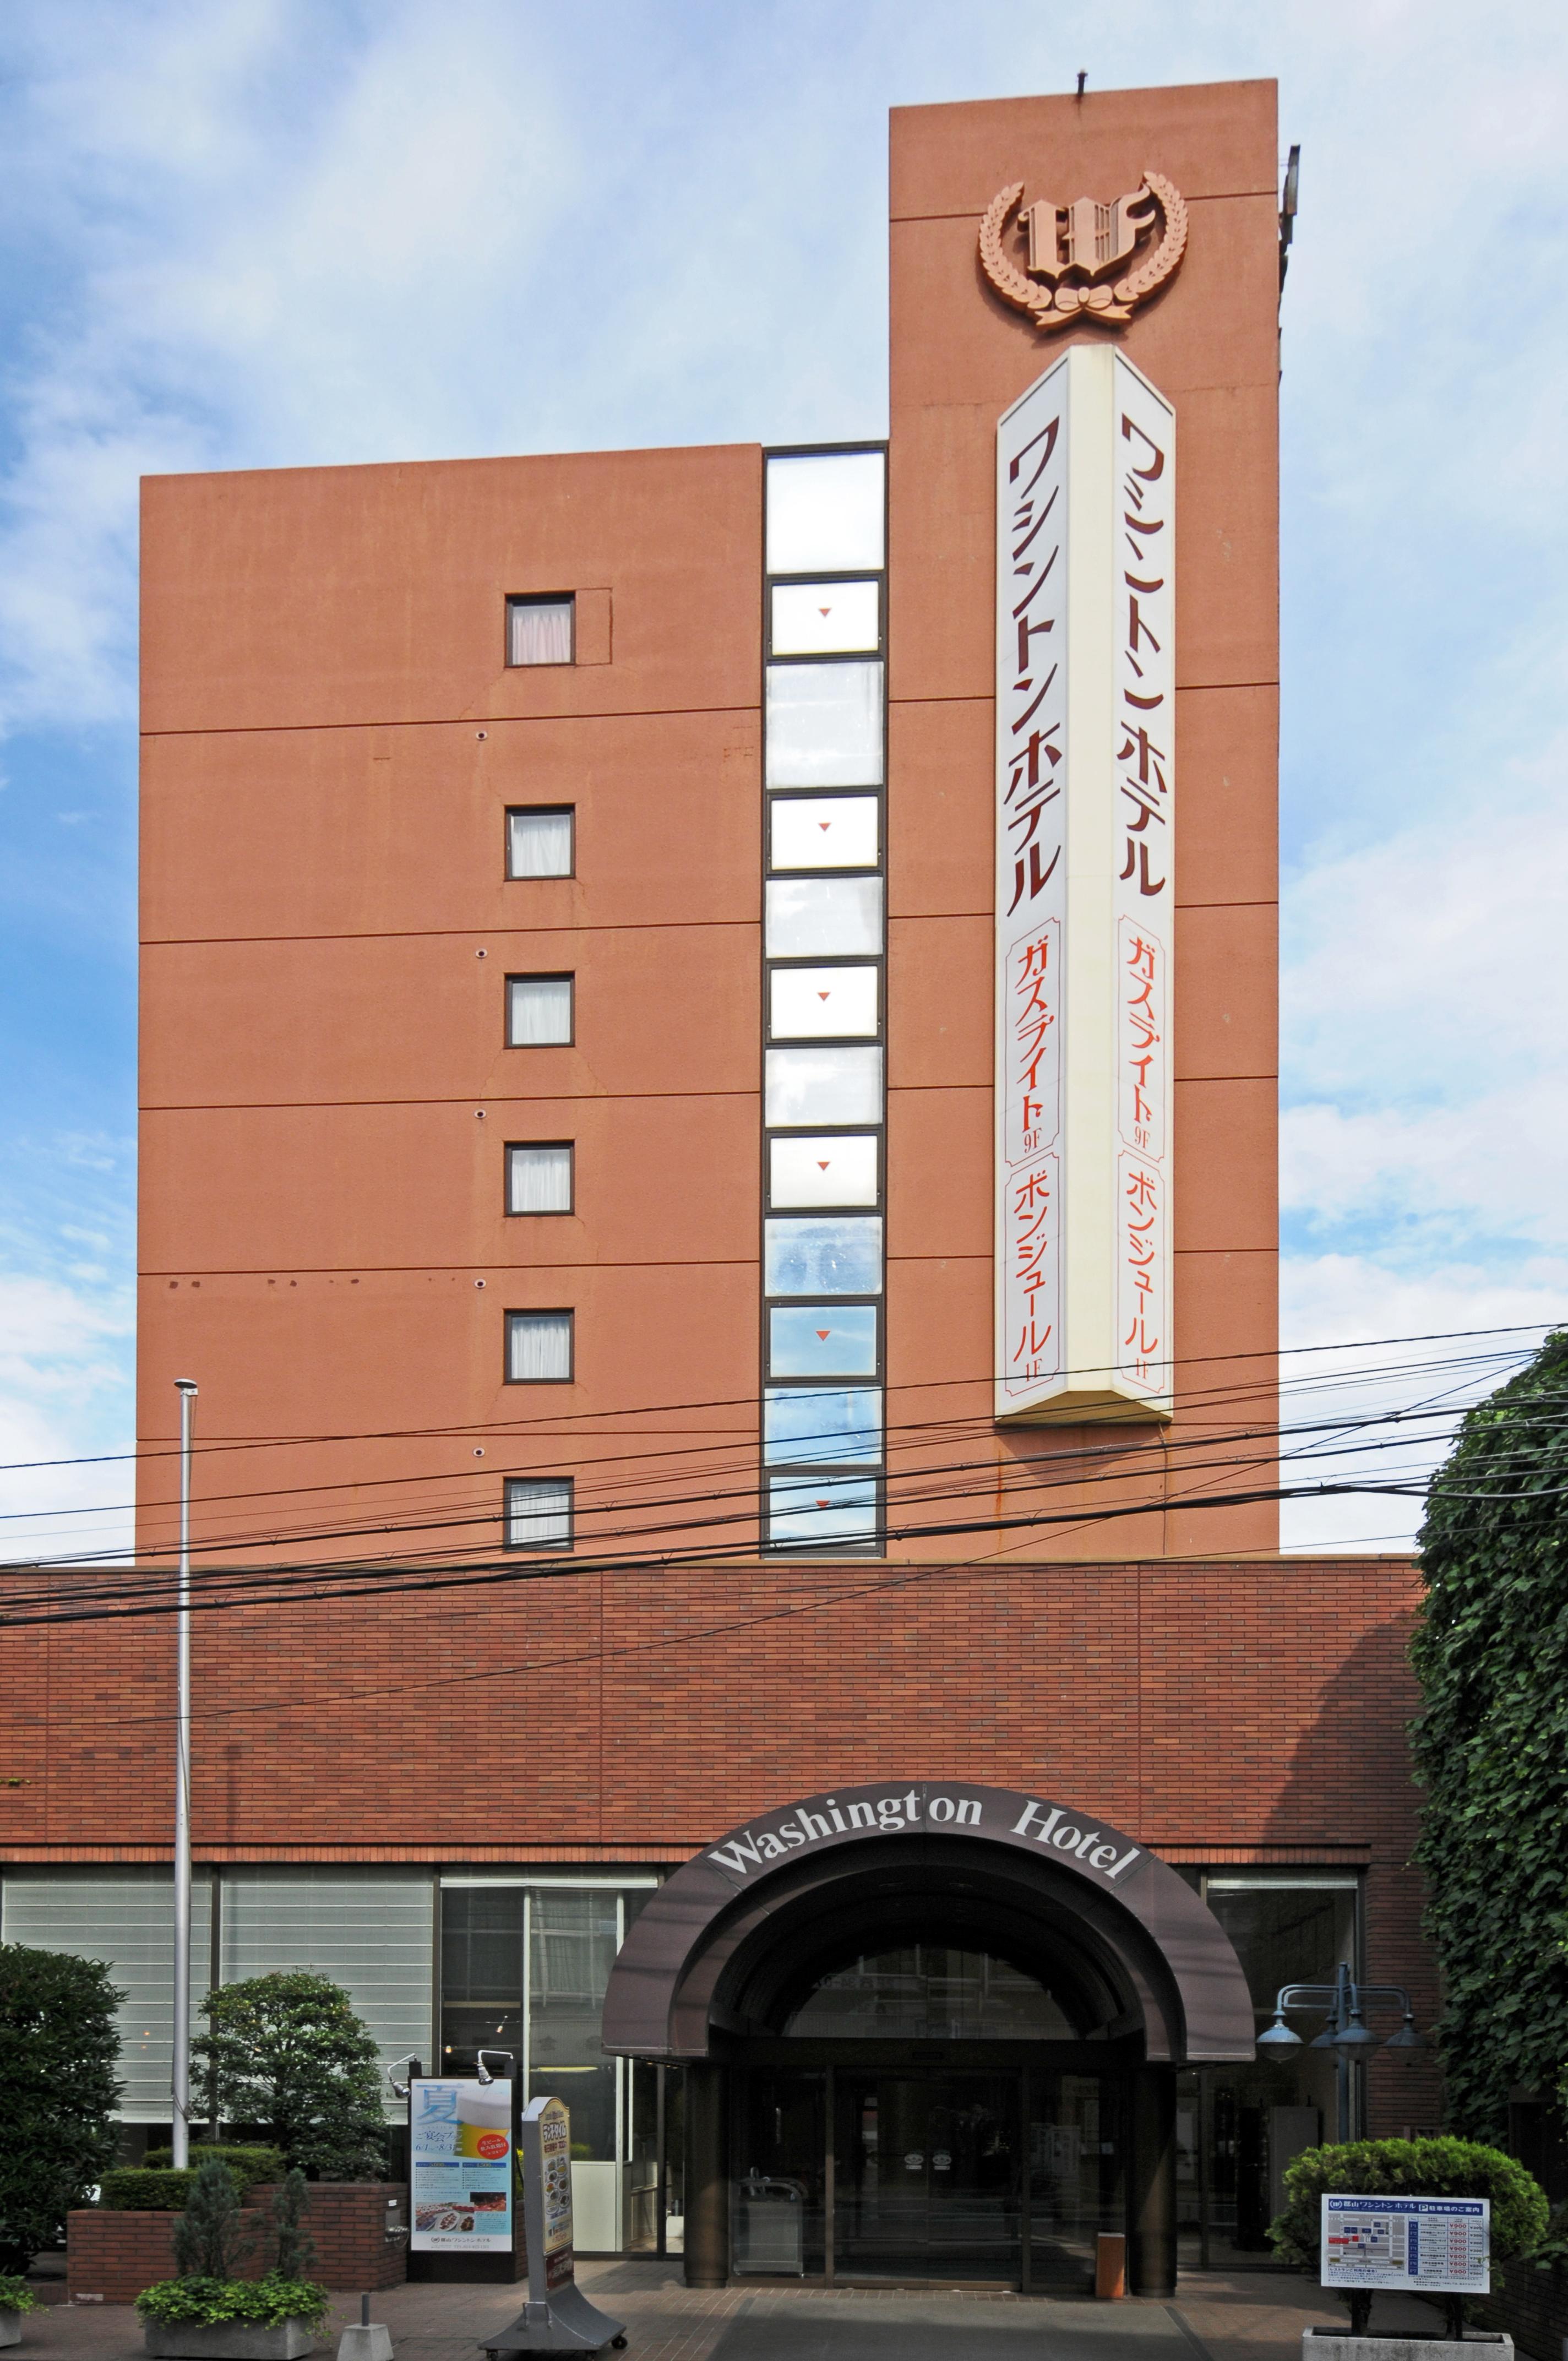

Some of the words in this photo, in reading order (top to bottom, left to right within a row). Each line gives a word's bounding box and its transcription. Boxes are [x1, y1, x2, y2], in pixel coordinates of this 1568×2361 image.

[1004, 414, 1063, 917] ワシントンホテル
[1117, 413, 1168, 896] ワシントンホテル
[1016, 934, 1053, 1132] ガスライト
[1126, 935, 1161, 1123] ガスライト
[1023, 1129, 1041, 1155] 9F
[1134, 1125, 1150, 1151] 9F
[1013, 1170, 1052, 1362] ボンジュール
[1124, 1171, 1159, 1355] ボンジュール
[1025, 1357, 1043, 1383] 1F
[1135, 1357, 1149, 1380] 1F
[707, 1789, 982, 1874] Washington
[1009, 1800, 1140, 1879] Hotel
[416, 2083, 464, 2125] 夏
